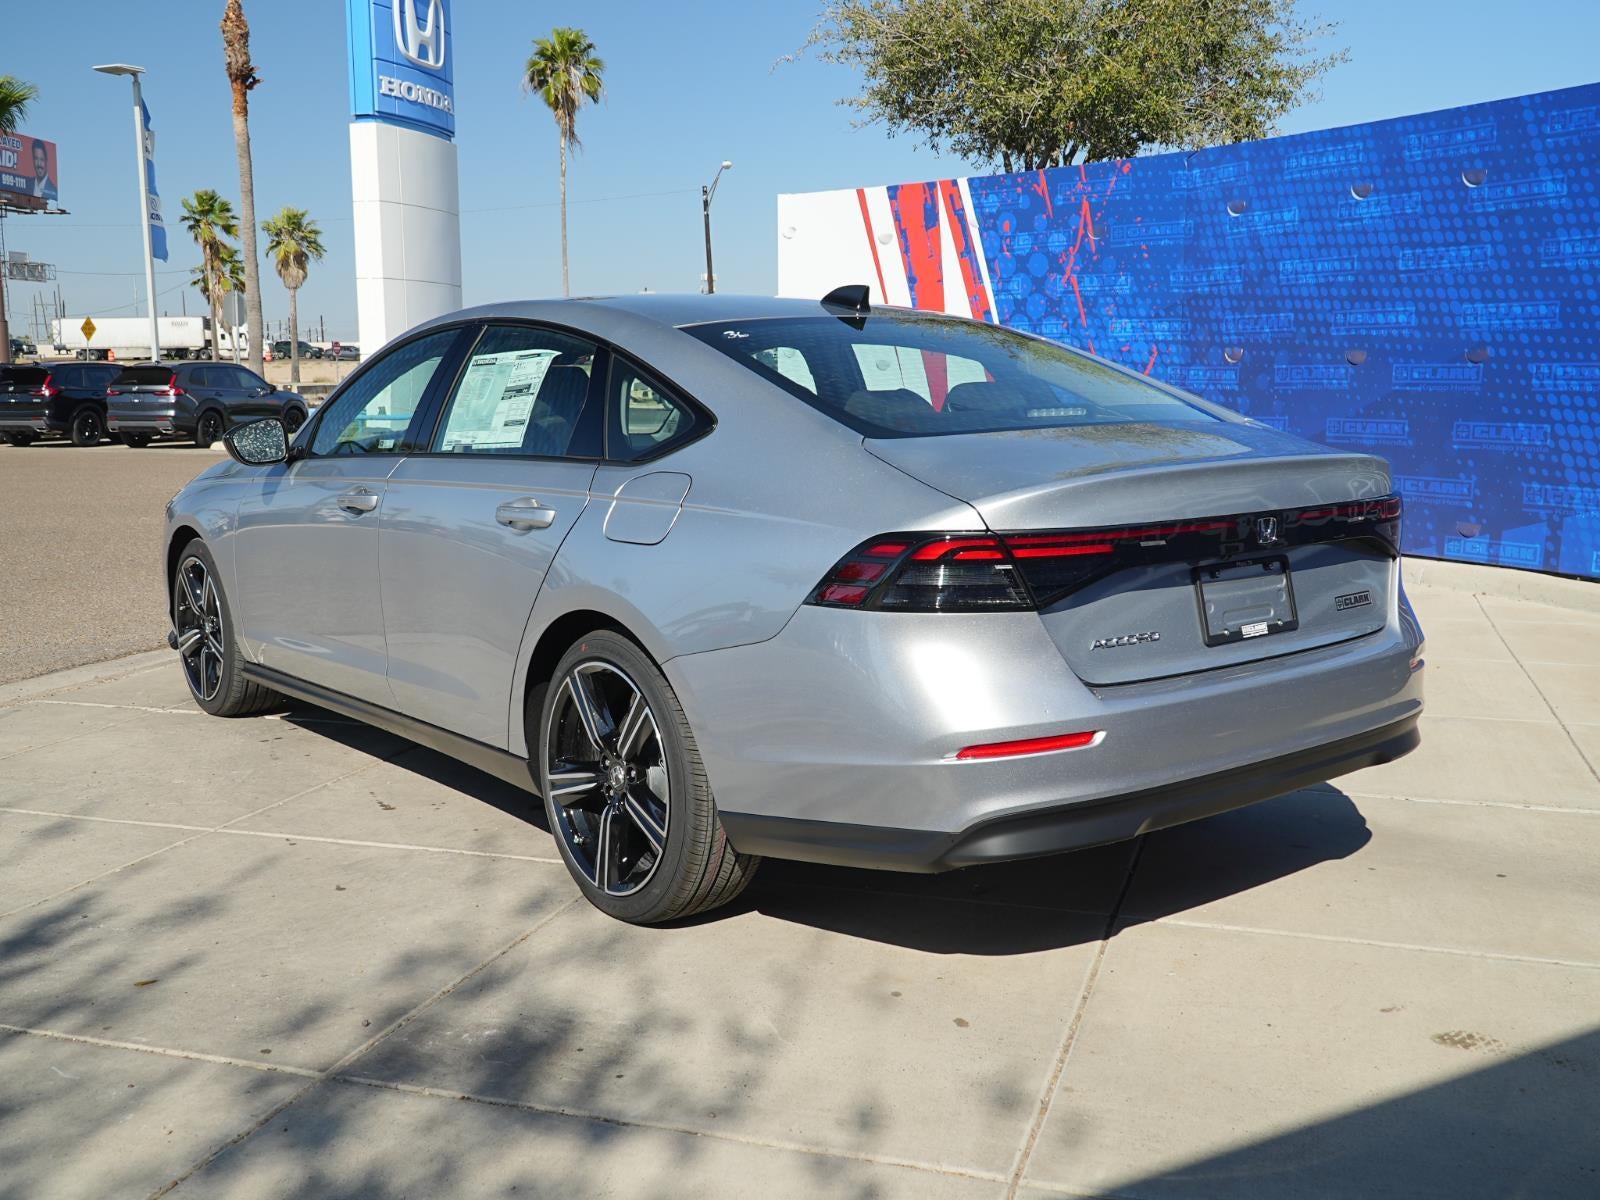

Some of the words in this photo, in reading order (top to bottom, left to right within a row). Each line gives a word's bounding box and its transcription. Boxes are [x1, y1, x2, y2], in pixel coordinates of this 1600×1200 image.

[379, 75, 455, 115] HONDA
[1473, 426, 1546, 443] CLARK
[1343, 593, 1370, 606] CLARK
[1089, 632, 1161, 651] ACCORD
